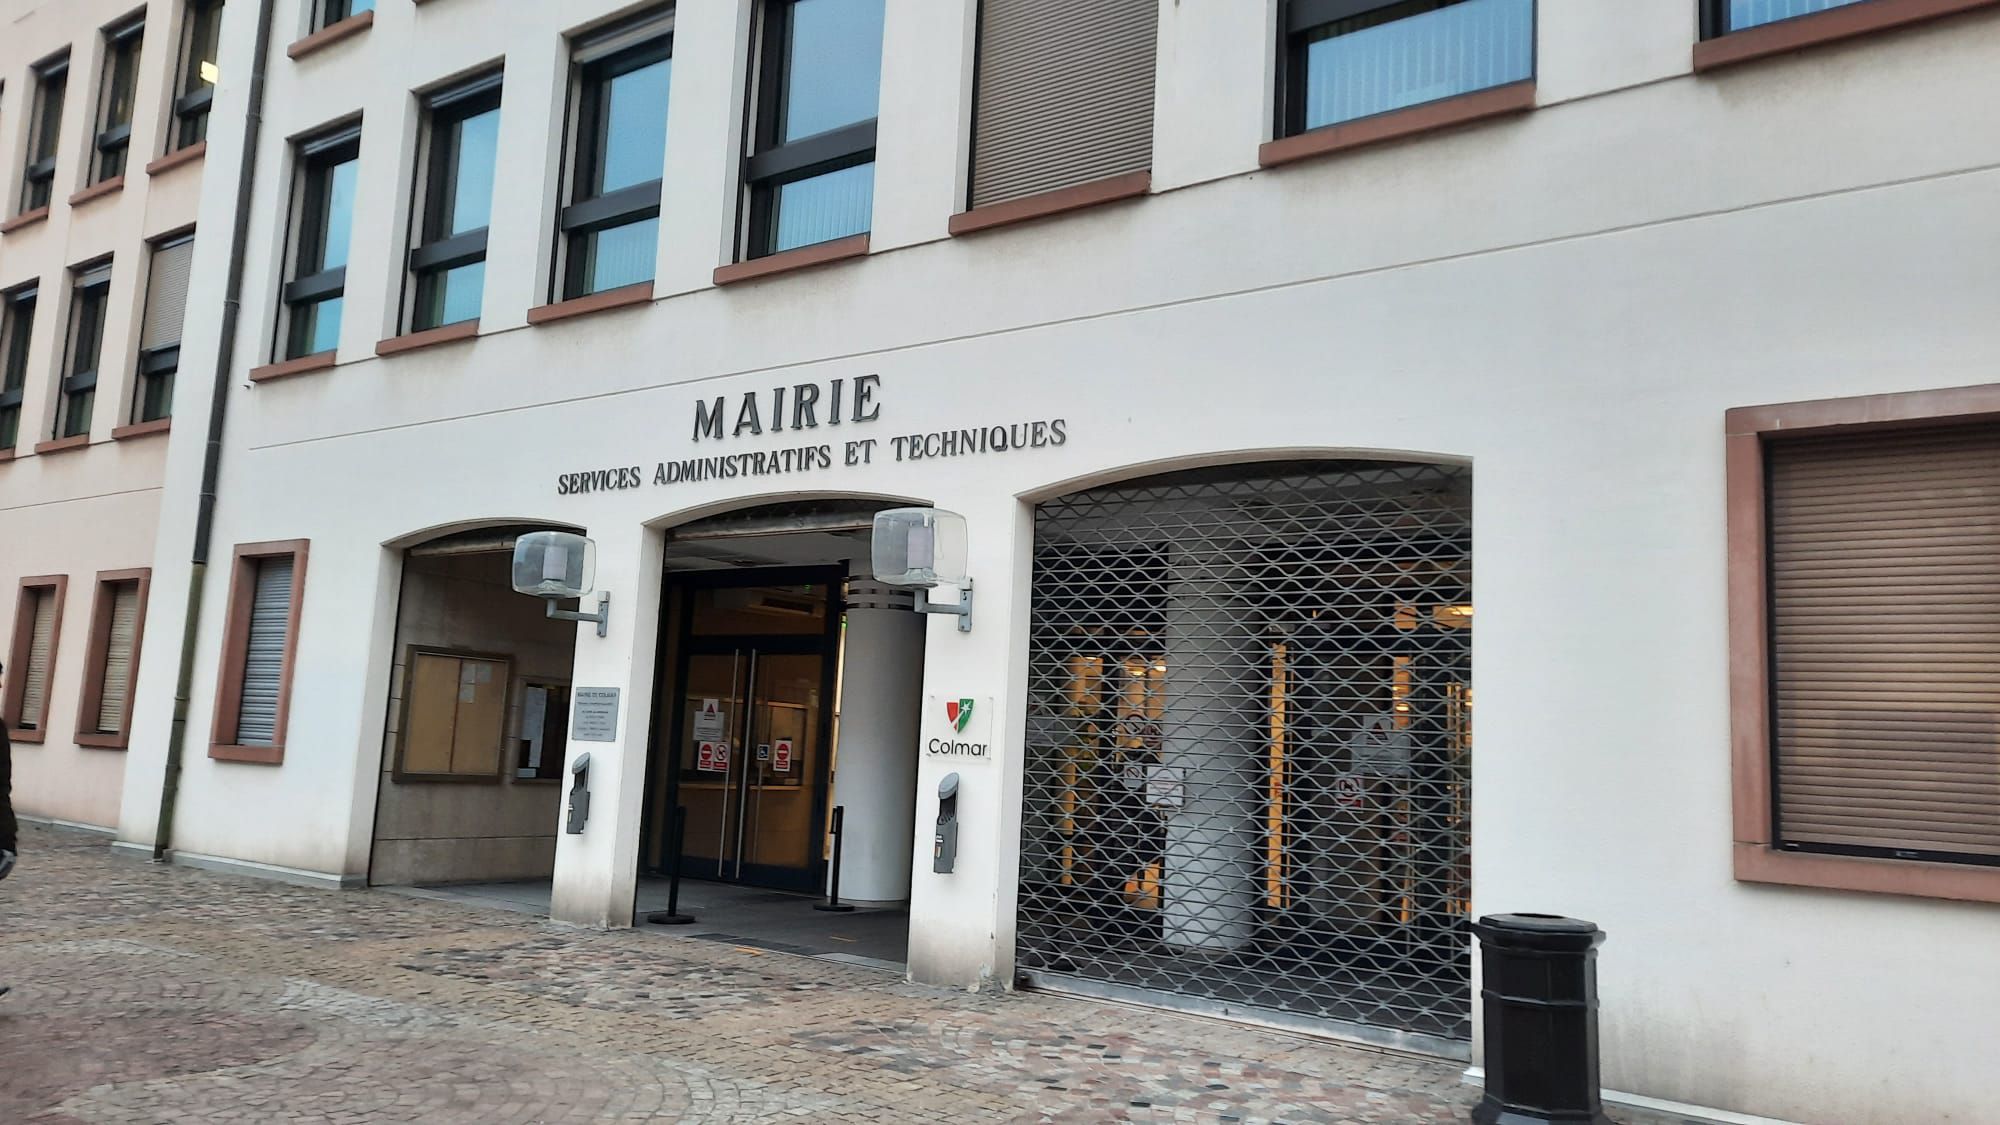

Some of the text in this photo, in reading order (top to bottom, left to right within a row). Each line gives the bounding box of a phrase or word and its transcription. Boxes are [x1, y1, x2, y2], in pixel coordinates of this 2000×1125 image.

[692, 374, 881, 443] MAIRIE
[558, 419, 1066, 496] SERVICES ADMINISTRATIFS ET TECHNIQUES
[928, 738, 988, 757] Colmar
